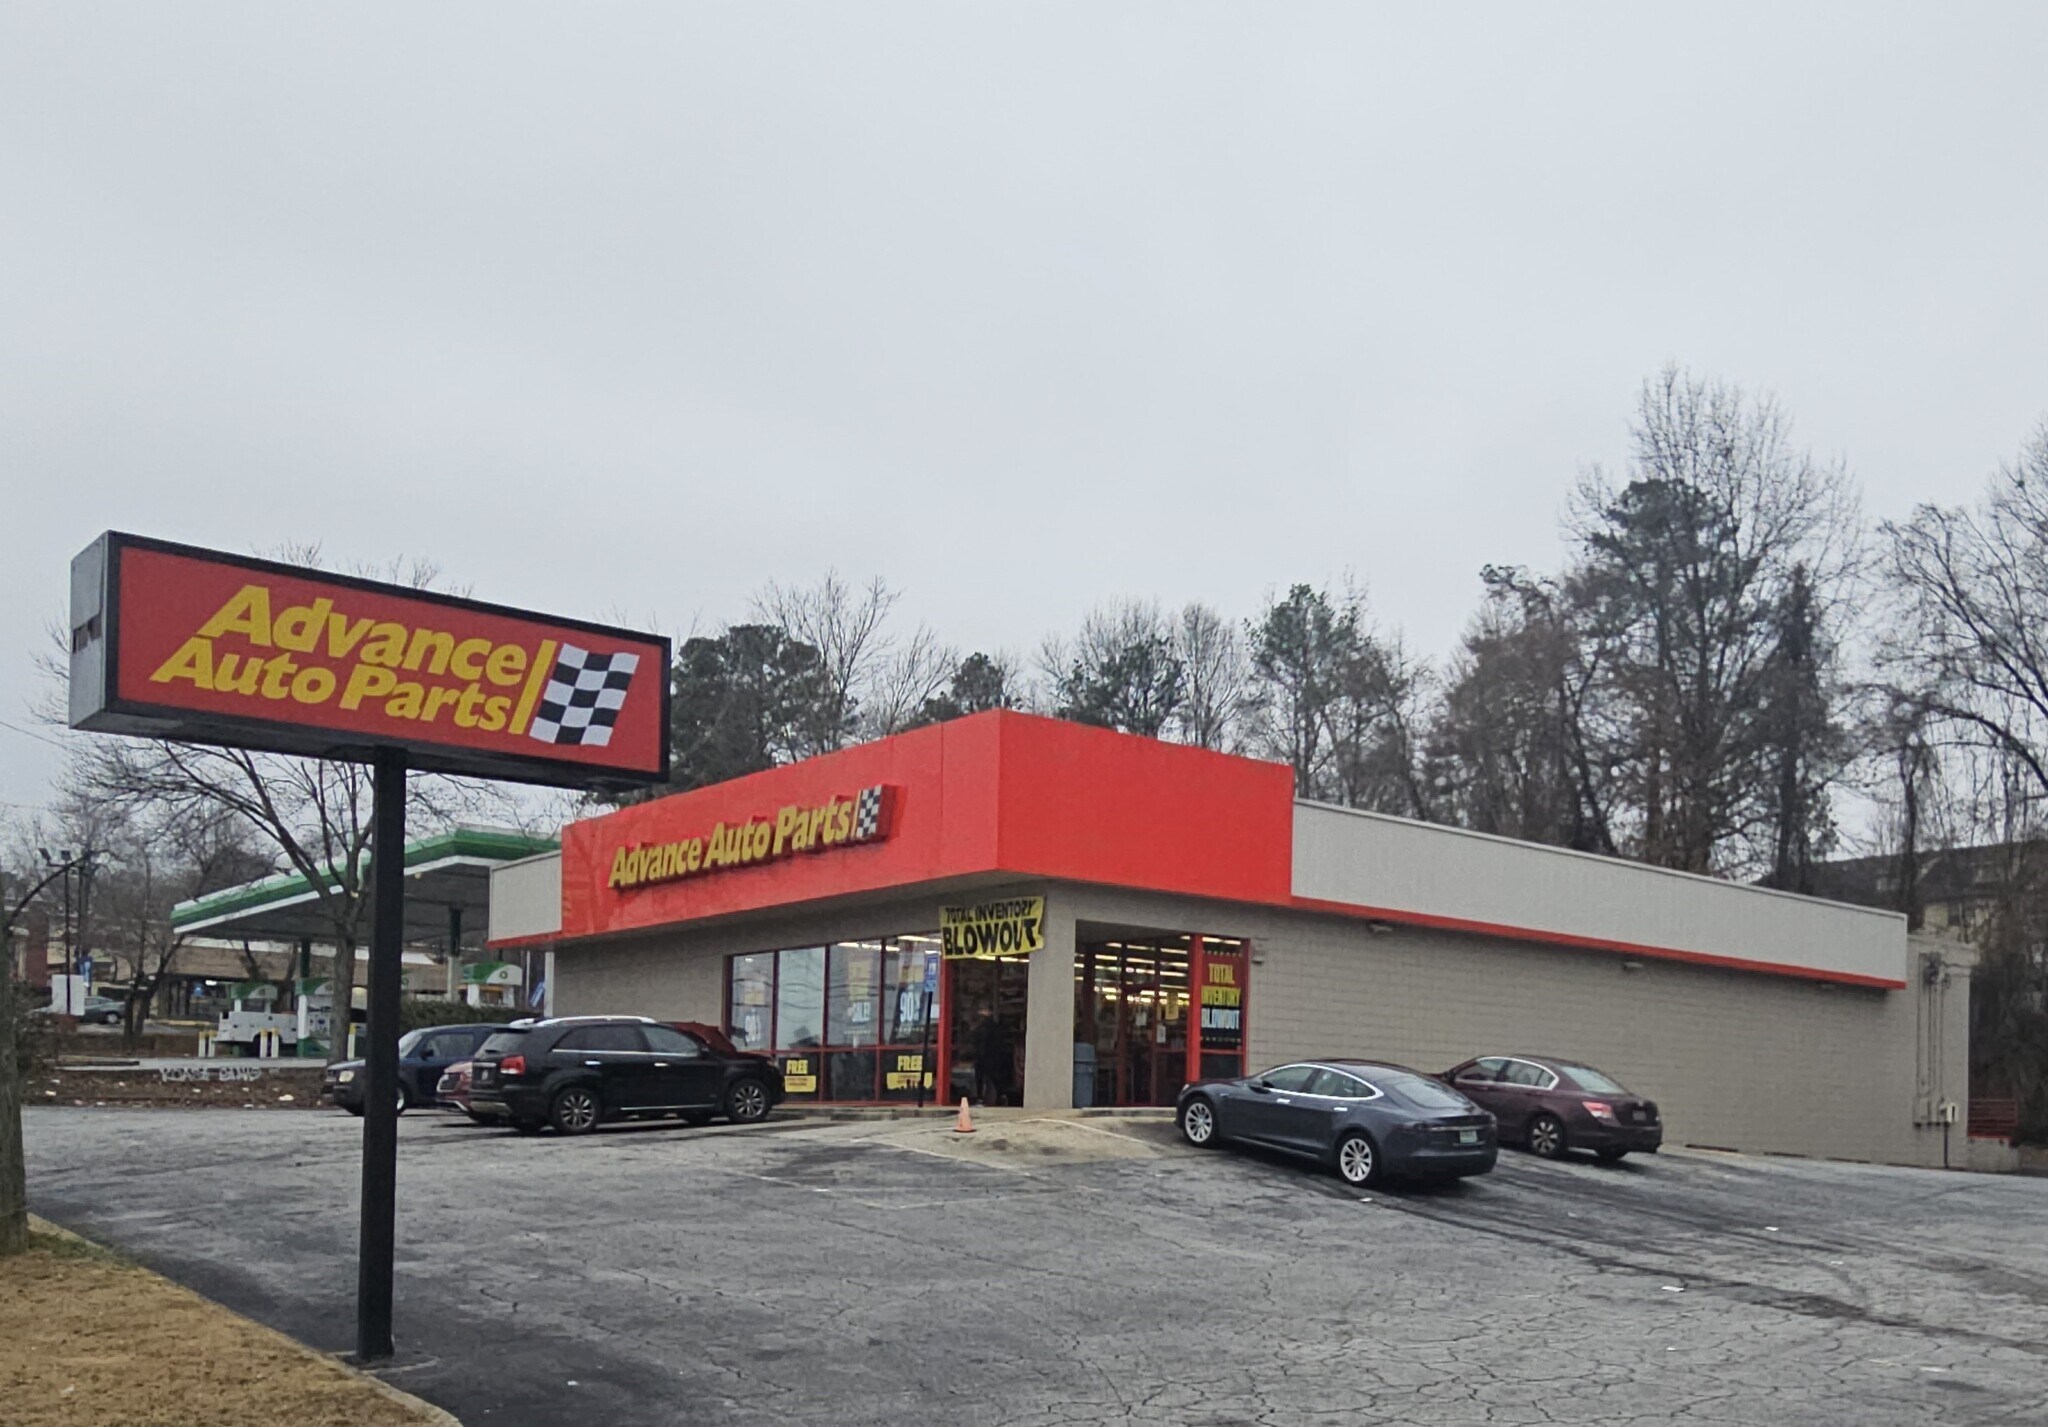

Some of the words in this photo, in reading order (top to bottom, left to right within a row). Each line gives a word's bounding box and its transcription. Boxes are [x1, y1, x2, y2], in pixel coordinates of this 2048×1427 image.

[196, 584, 528, 686] Advance
[149, 636, 338, 705] Auto
[339, 663, 512, 731] Parts
[607, 846, 700, 888] Advance
[702, 822, 771, 868] Auto
[772, 797, 853, 856] Parts
[942, 918, 1038, 956] BLOWOUT
[945, 906, 973, 924] TOTAL
[975, 898, 1036, 922] INVENTORY
